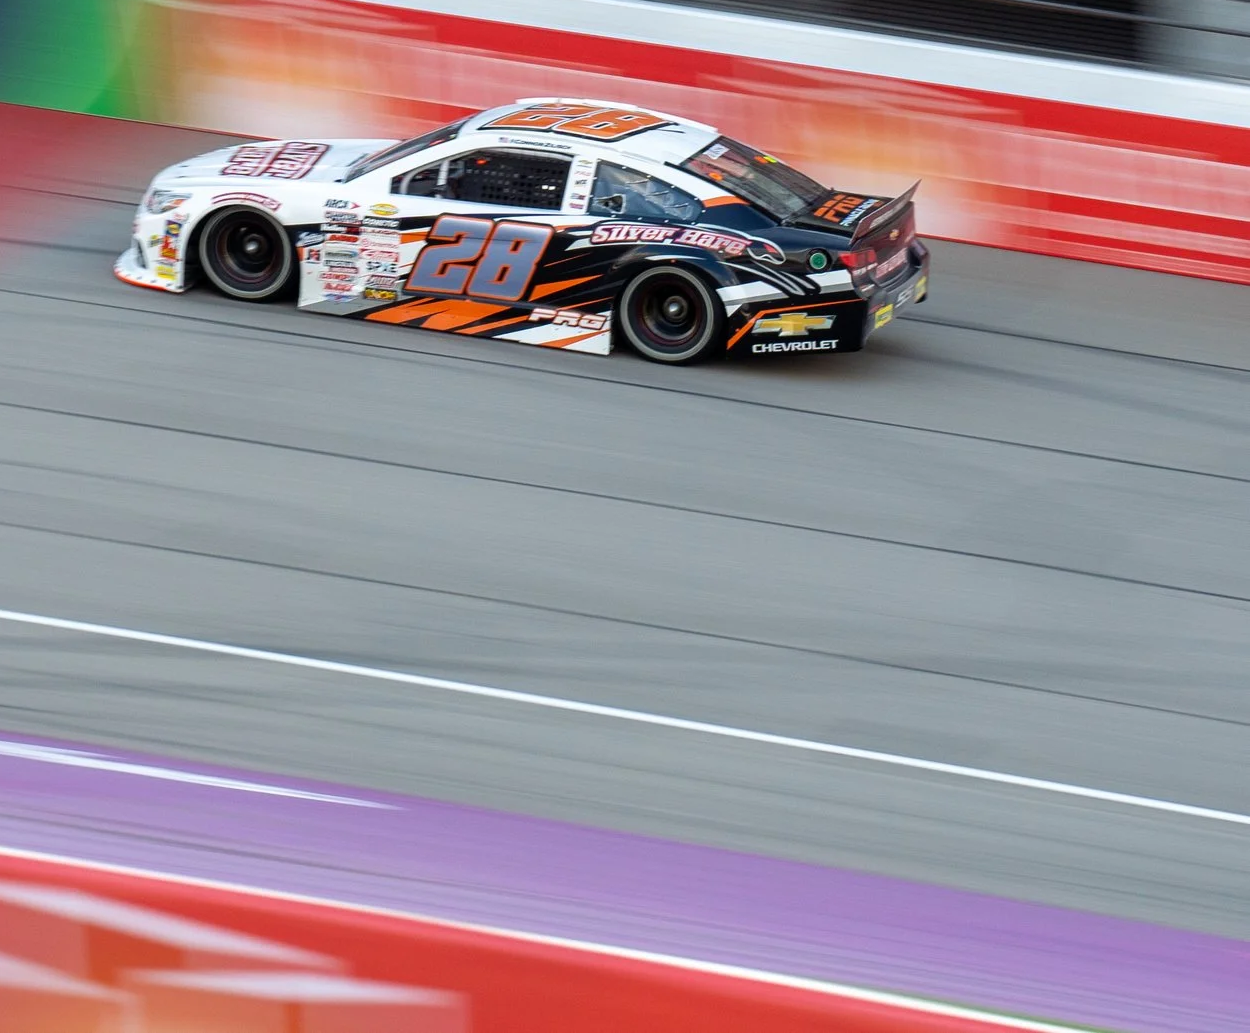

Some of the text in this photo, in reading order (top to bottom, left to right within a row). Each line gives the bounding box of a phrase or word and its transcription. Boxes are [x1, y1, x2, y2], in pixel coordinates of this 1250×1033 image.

[478, 102, 670, 142] 28
[591, 225, 753, 256] Silver Hare
[403, 213, 555, 303] 28
[528, 307, 608, 331] PRG
[752, 339, 839, 353] CHEVROLET
